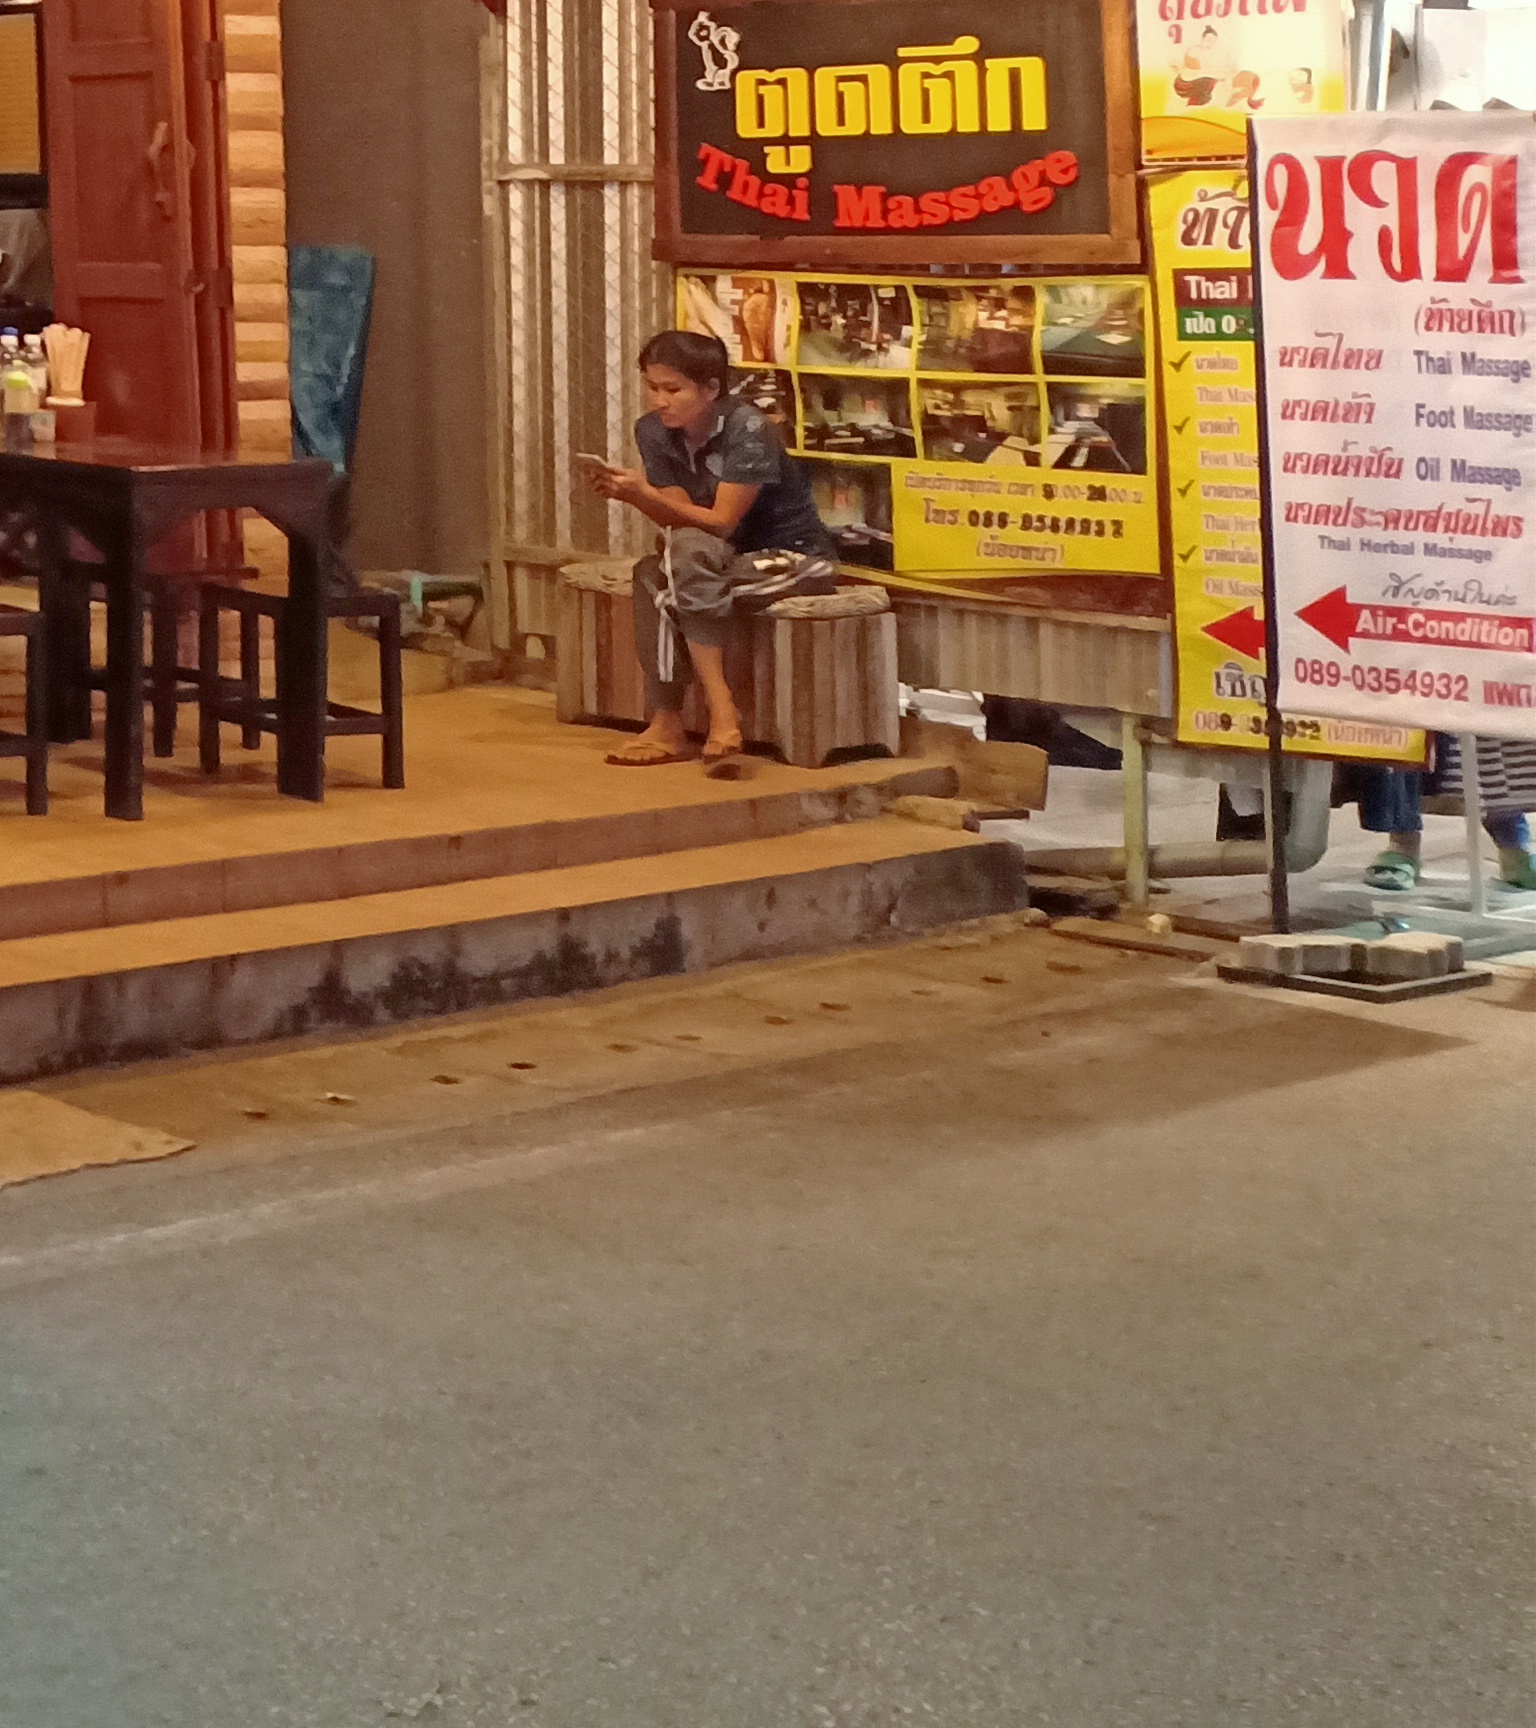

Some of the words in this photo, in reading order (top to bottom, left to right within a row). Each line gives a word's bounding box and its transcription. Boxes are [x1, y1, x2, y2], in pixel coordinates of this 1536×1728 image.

[734, 35, 1048, 174] ตูดตึก
[696, 143, 811, 220] Thai
[832, 149, 1080, 229] Massage
[1264, 149, 1526, 285] นวด
[1184, 275, 1238, 300] Thai
[1278, 329, 1384, 371] นวดไทย
[1413, 349, 1453, 375] Thai
[1460, 351, 1532, 383] Massage
[1280, 390, 1376, 424] นวดเท้า
[1414, 403, 1456, 430] Foot
[1462, 405, 1534, 438] Massage
[1415, 456, 1441, 483] Oil
[1450, 458, 1523, 491] Massage
[1284, 497, 1525, 544] นวดประคบสมุนไพร
[1318, 535, 1352, 552] Thai
[1359, 537, 1416, 556] Herbal
[1423, 542, 1494, 563] Massage
[1354, 608, 1530, 648] Air-Condition
[1293, 656, 1470, 703] 089-0354932
